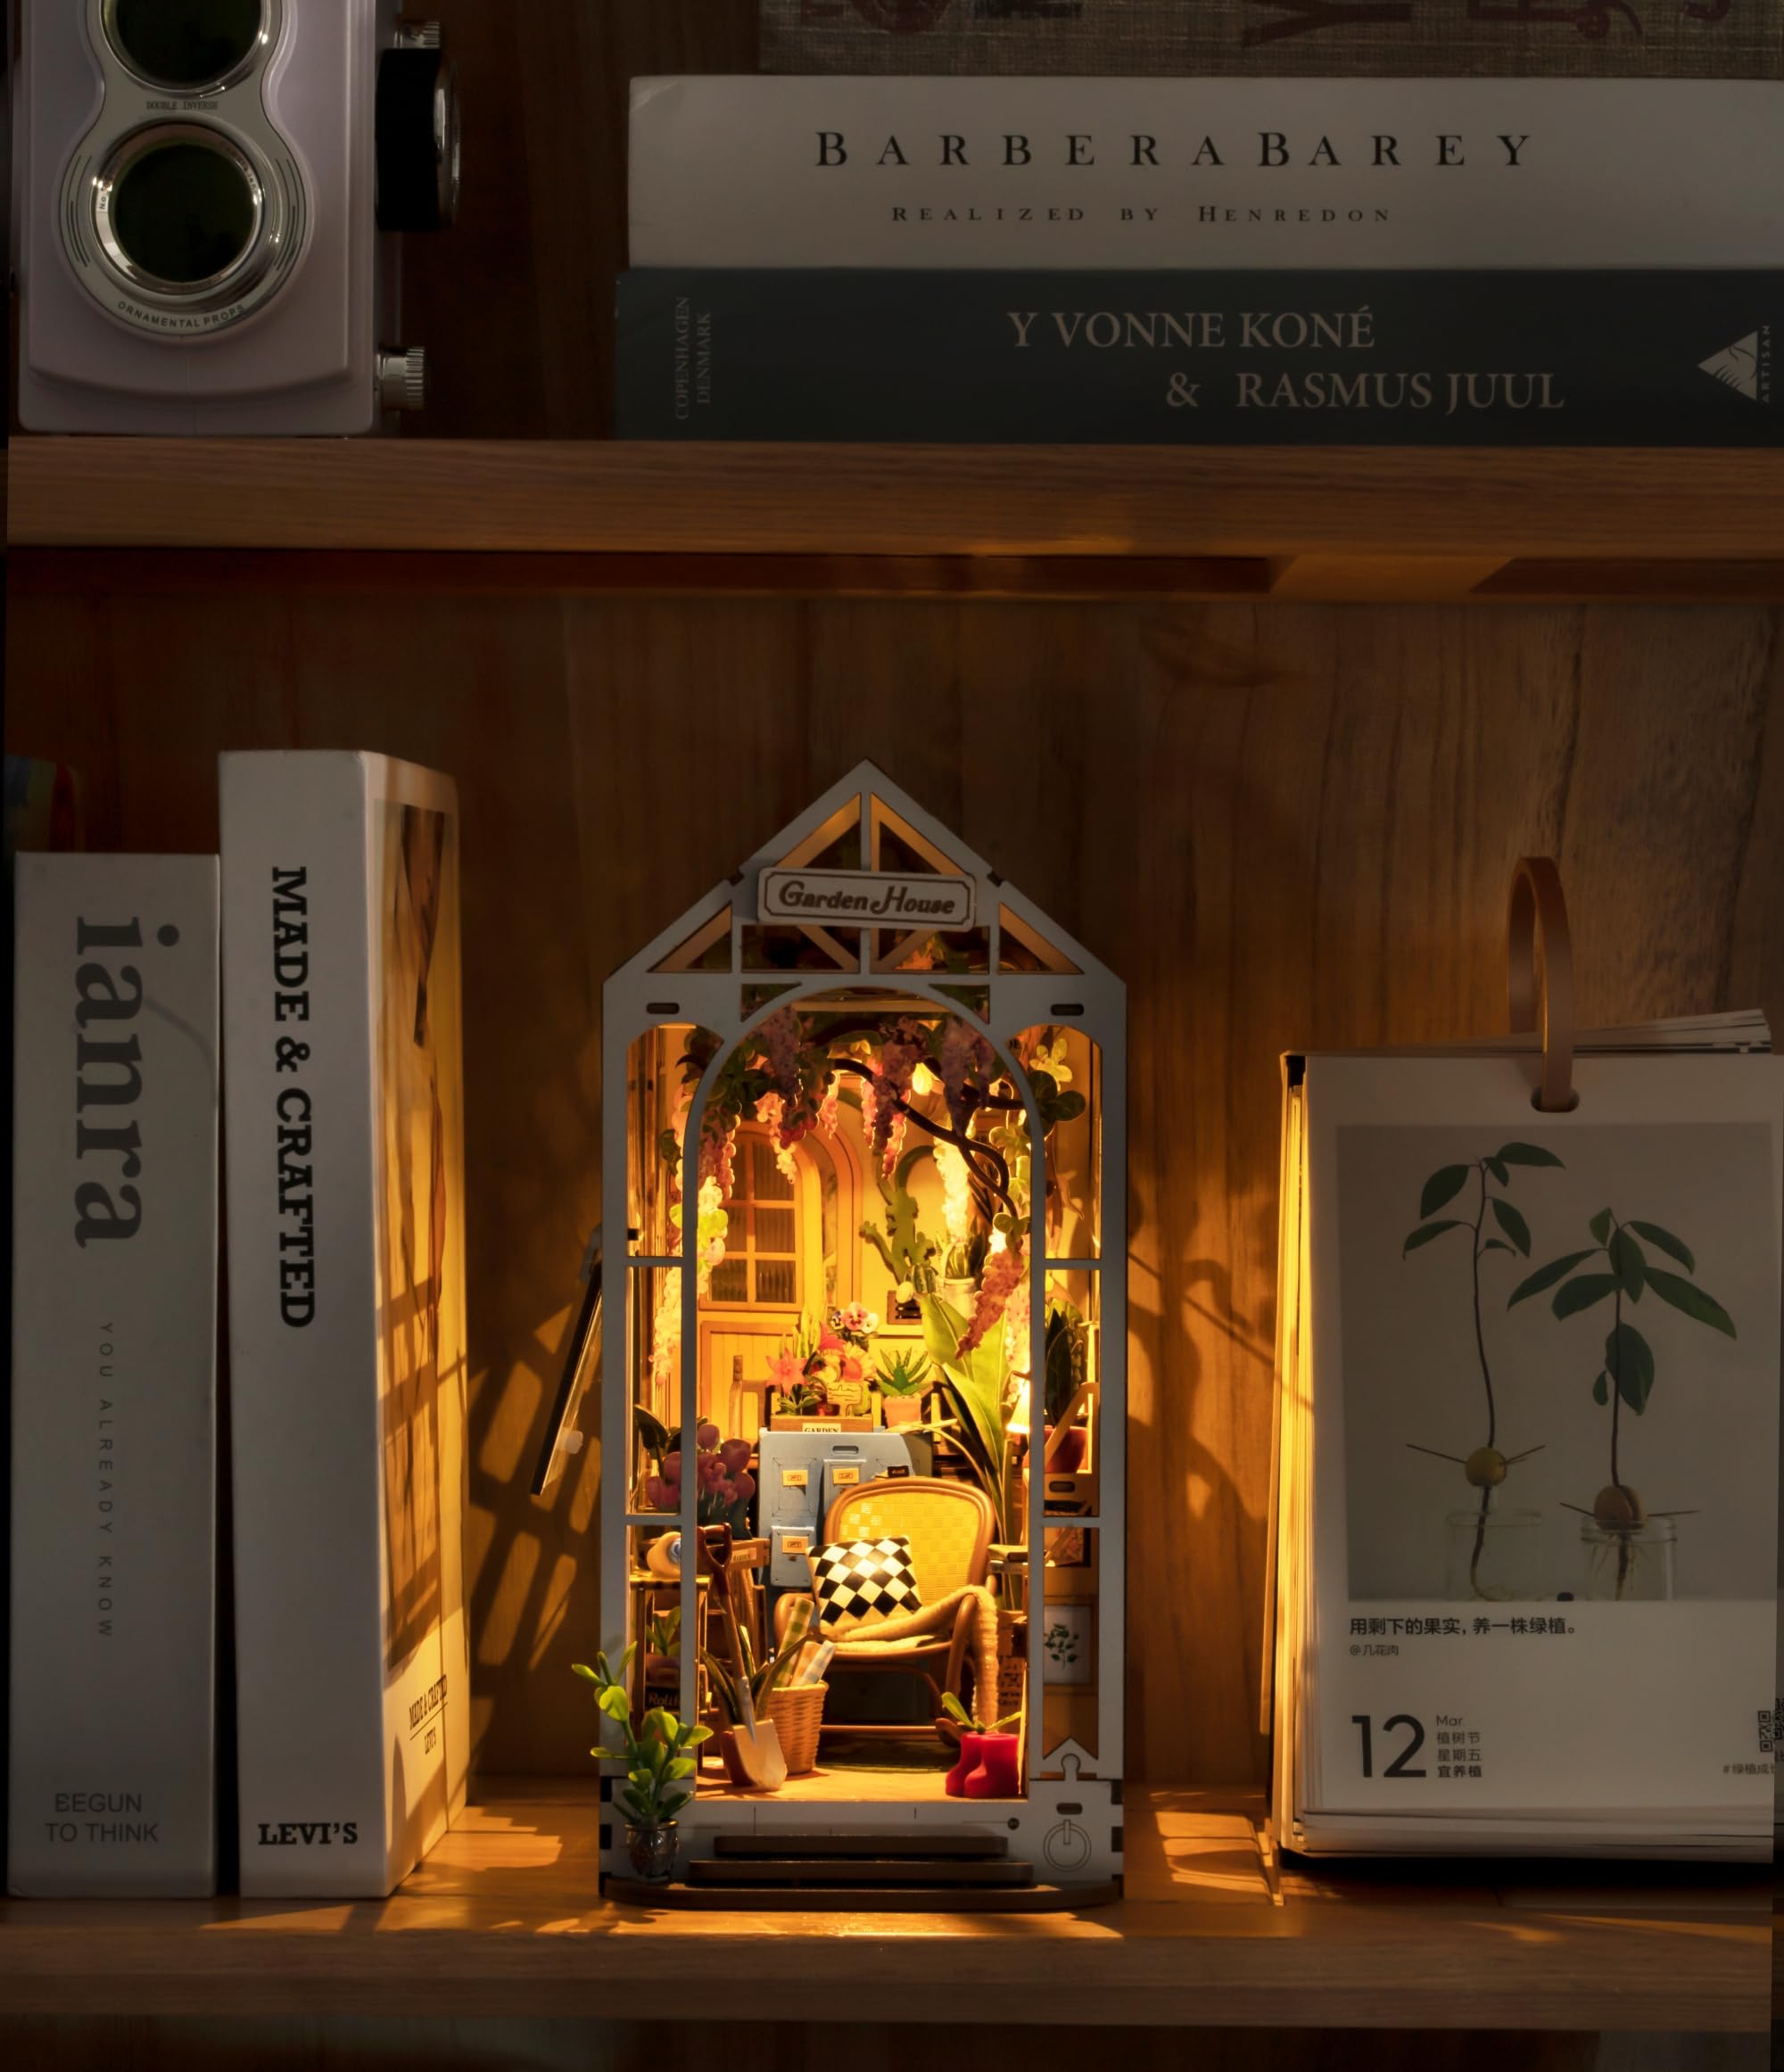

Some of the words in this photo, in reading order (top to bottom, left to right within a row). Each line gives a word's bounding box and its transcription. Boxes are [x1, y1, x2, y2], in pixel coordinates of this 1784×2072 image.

[146, 100, 178, 111] DOUBLE
[183, 100, 219, 111] INVERSE
[891, 207, 1084, 222] REALIZED
[1120, 208, 1157, 221] BY
[117, 301, 201, 327] ORNAMENTAL
[203, 303, 244, 326] PROPS
[1239, 304, 1375, 348] KONÉ
[675, 297, 690, 421] COPENHAGEN
[697, 313, 712, 408] DENMARK
[1762, 325, 1771, 404] ARTISAN
[1166, 372, 1200, 408] &
[1236, 372, 1433, 408] RASMUS
[1446, 373, 1565, 416] JUUL
[779, 879, 869, 911] Garden
[870, 885, 955, 915] House
[272, 866, 310, 1022] MADE
[275, 1036, 311, 1073] &
[276, 1087, 316, 1328] CRAFTED
[99, 1322, 114, 1377] YOU
[98, 1399, 113, 1533] ALREADY
[98, 1556, 113, 1637] KNOW
[1435, 1714, 1464, 1727] Mar
[1436, 1730, 1481, 1745] 植树节
[1351, 1713, 1428, 1779] 12
[1437, 1748, 1482, 1762] 星期五
[54, 1793, 143, 1813] BEGUN
[45, 1822, 78, 1843] TO
[85, 1822, 158, 1842] THINK
[258, 1822, 358, 1845] LEVI'S
